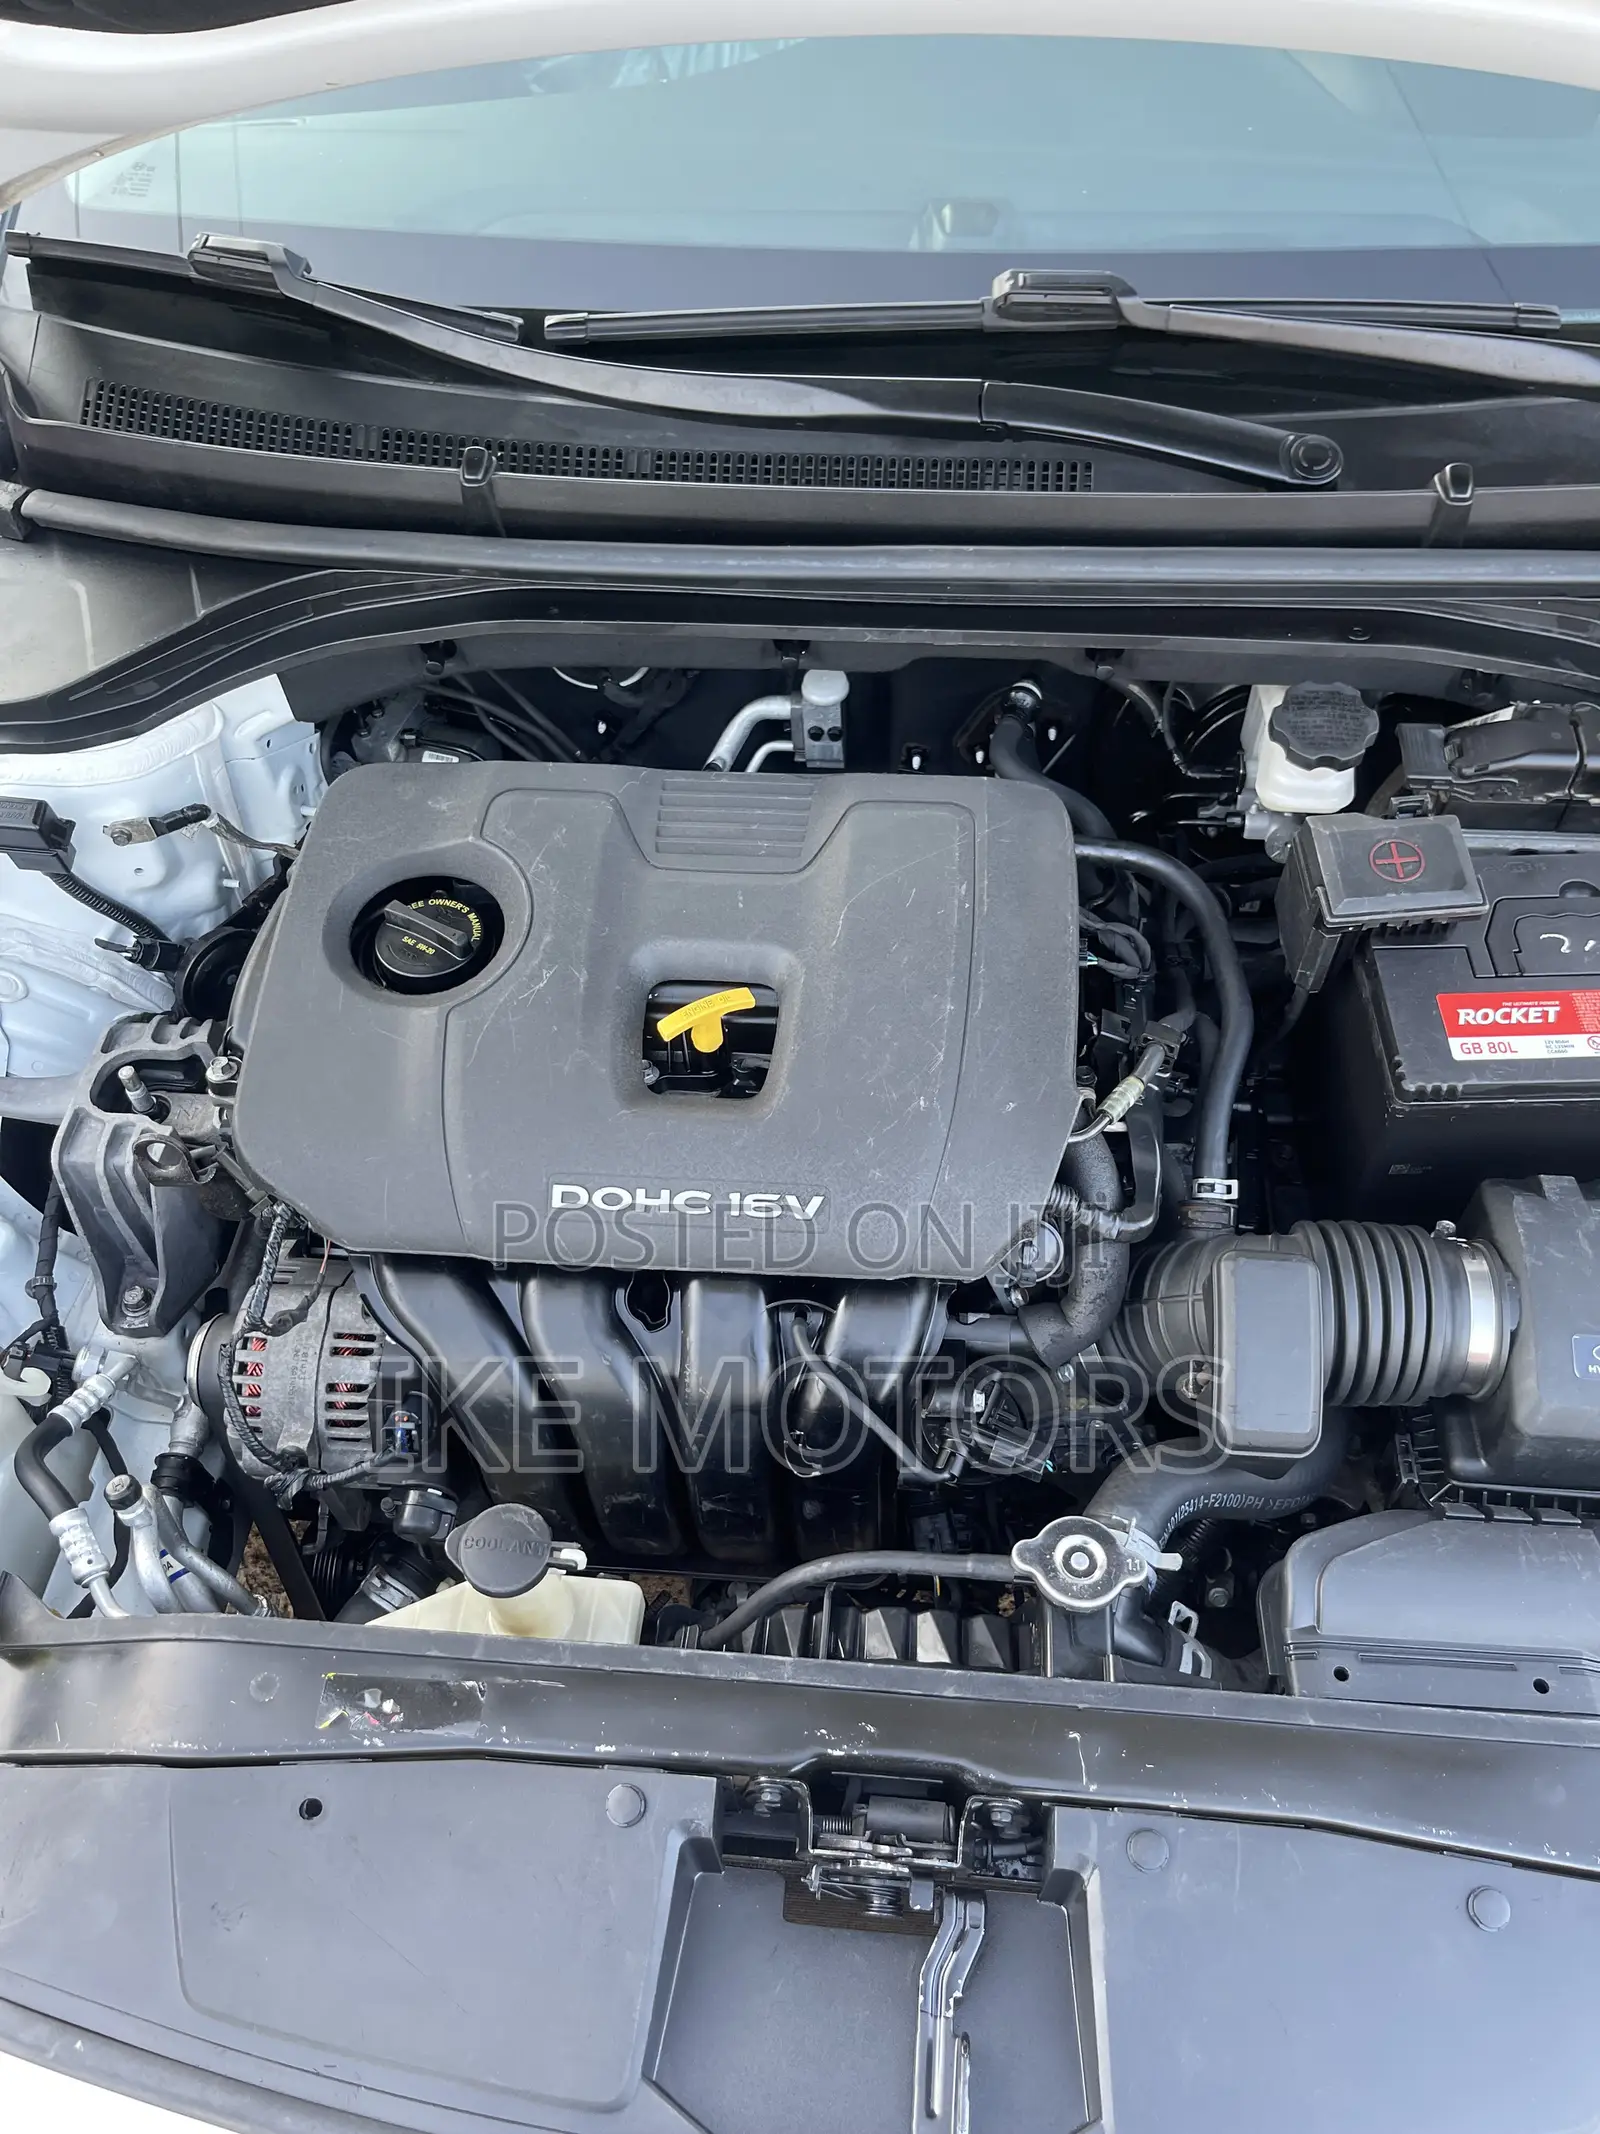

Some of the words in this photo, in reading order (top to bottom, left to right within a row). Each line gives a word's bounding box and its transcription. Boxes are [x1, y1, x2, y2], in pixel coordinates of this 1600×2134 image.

[428, 899, 470, 914] OWNER'S
[467, 912, 482, 942] MANUAL
[401, 935, 417, 946] SAE
[681, 999, 714, 1019] ENGINE
[1456, 1007, 1560, 1025] ROCKET
[1460, 1043, 1483, 1054] GB
[1488, 1042, 1518, 1054] 80L
[552, 1184, 712, 1215] DOHC
[729, 1192, 825, 1221] 16V
[463, 1535, 549, 1557] COOLANT
